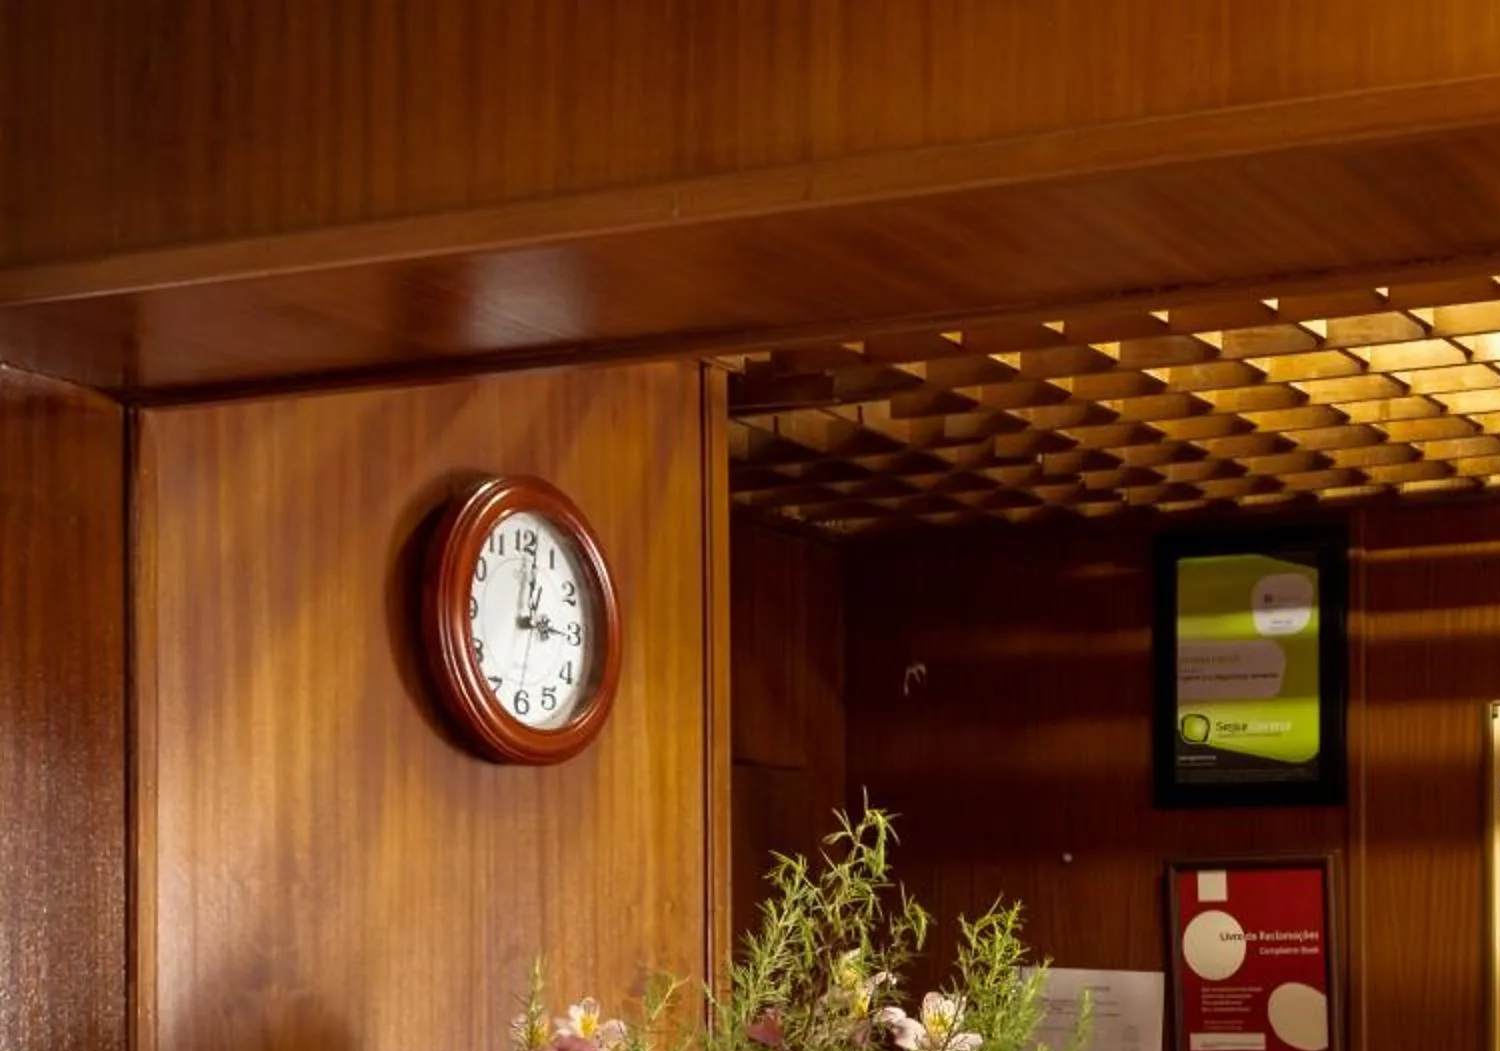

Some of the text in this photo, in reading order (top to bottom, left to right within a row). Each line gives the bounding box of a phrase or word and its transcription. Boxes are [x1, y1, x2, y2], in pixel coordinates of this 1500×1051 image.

[489, 532, 504, 556] 11
[515, 528, 537, 556] 12
[550, 548, 556, 570] 1
[561, 580, 577, 607] 2
[566, 622, 581, 647] 3
[559, 660, 573, 686] 4
[513, 688, 530, 715] 6
[541, 686, 557, 711] 5
